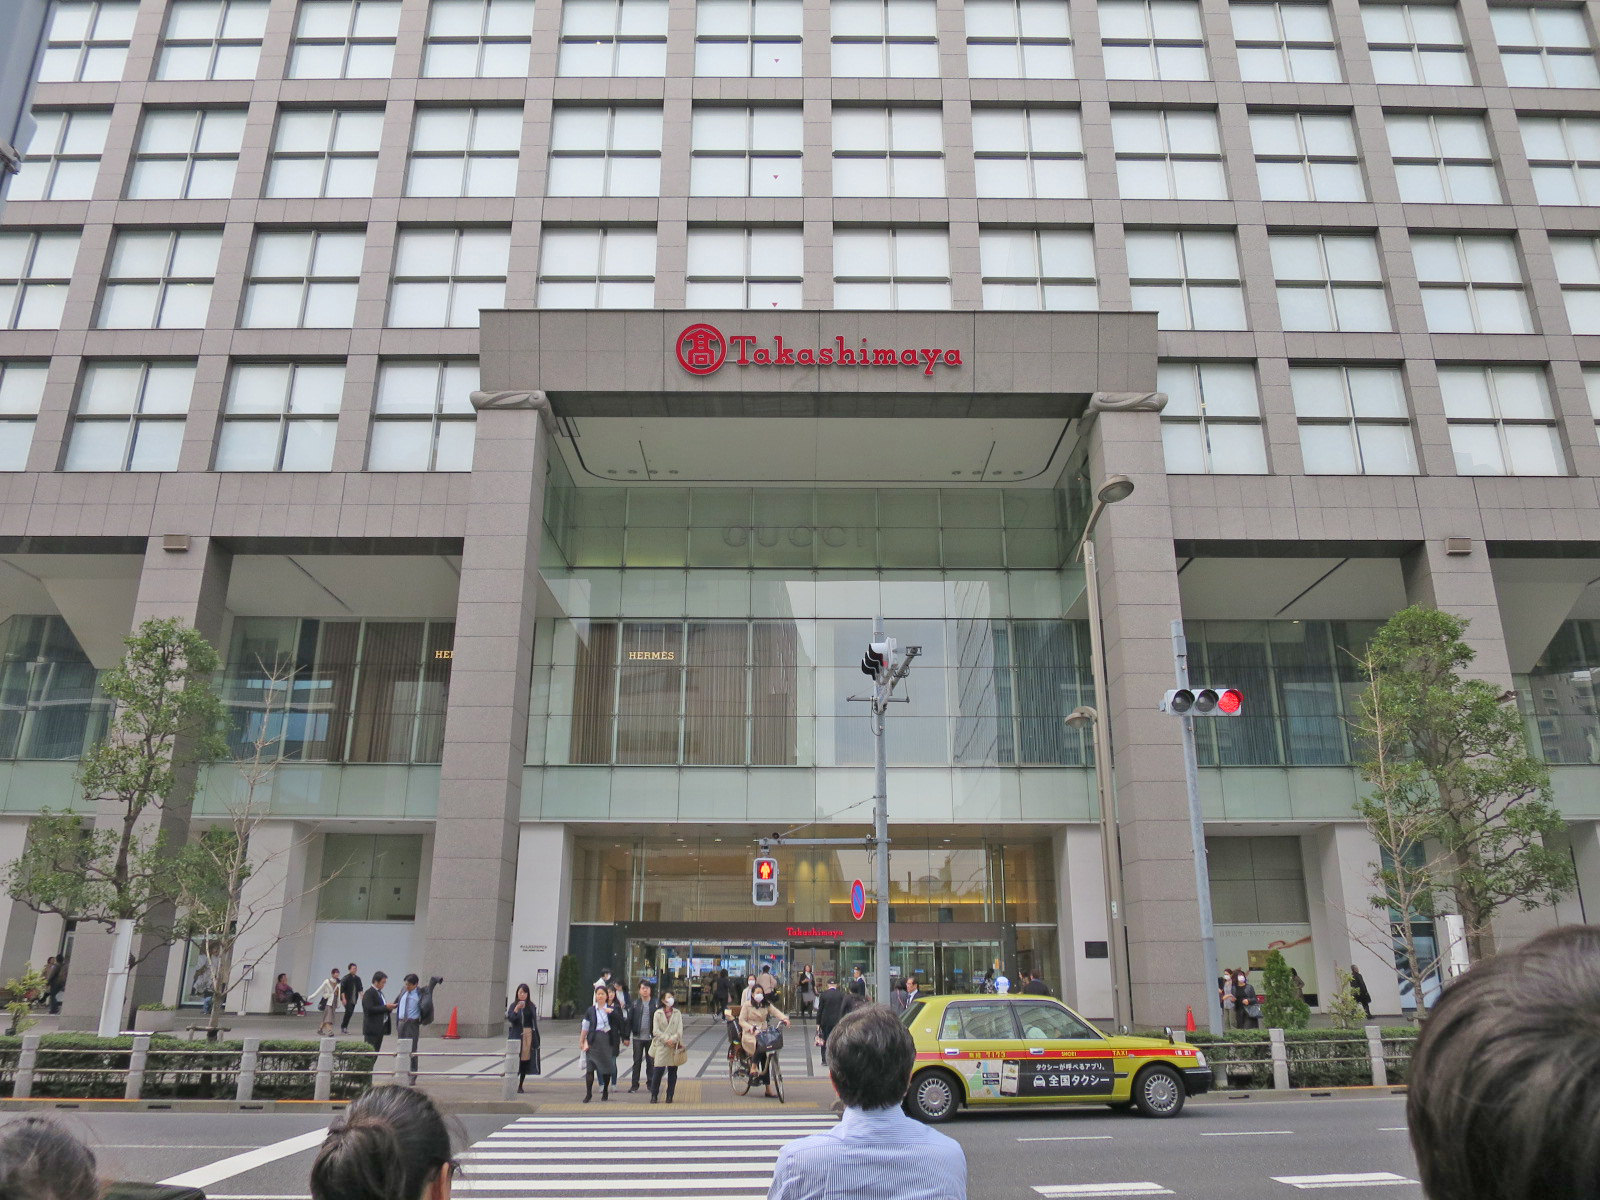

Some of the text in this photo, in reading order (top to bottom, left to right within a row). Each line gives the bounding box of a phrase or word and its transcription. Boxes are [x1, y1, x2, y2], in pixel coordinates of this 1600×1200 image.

[729, 335, 963, 375] Takashimaya
[722, 523, 865, 548] GUCCI
[786, 927, 844, 938] Takashimaya
[1049, 1074, 1110, 1087] 全国タクシー
